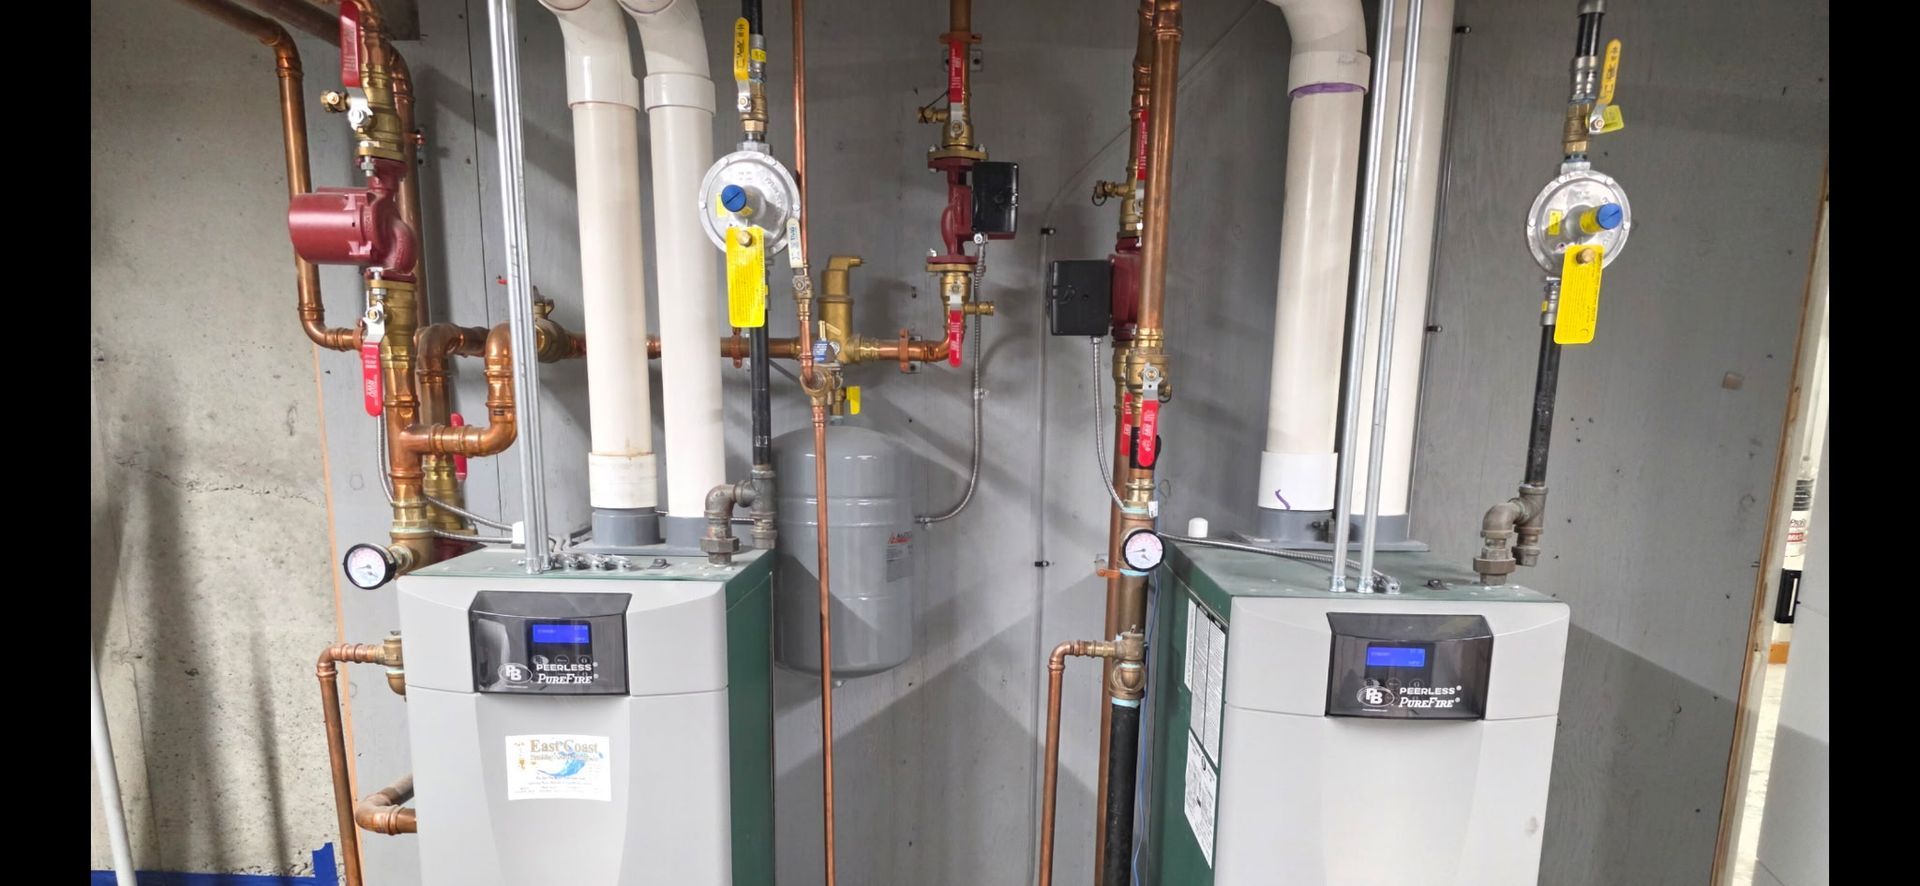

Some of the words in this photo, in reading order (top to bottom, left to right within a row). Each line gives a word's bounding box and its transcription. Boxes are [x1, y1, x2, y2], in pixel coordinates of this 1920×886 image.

[536, 663, 592, 672] PEERLESS
[1399, 687, 1456, 695] PEERLESS
[530, 739, 560, 753] East
[563, 739, 598, 753] Coast
